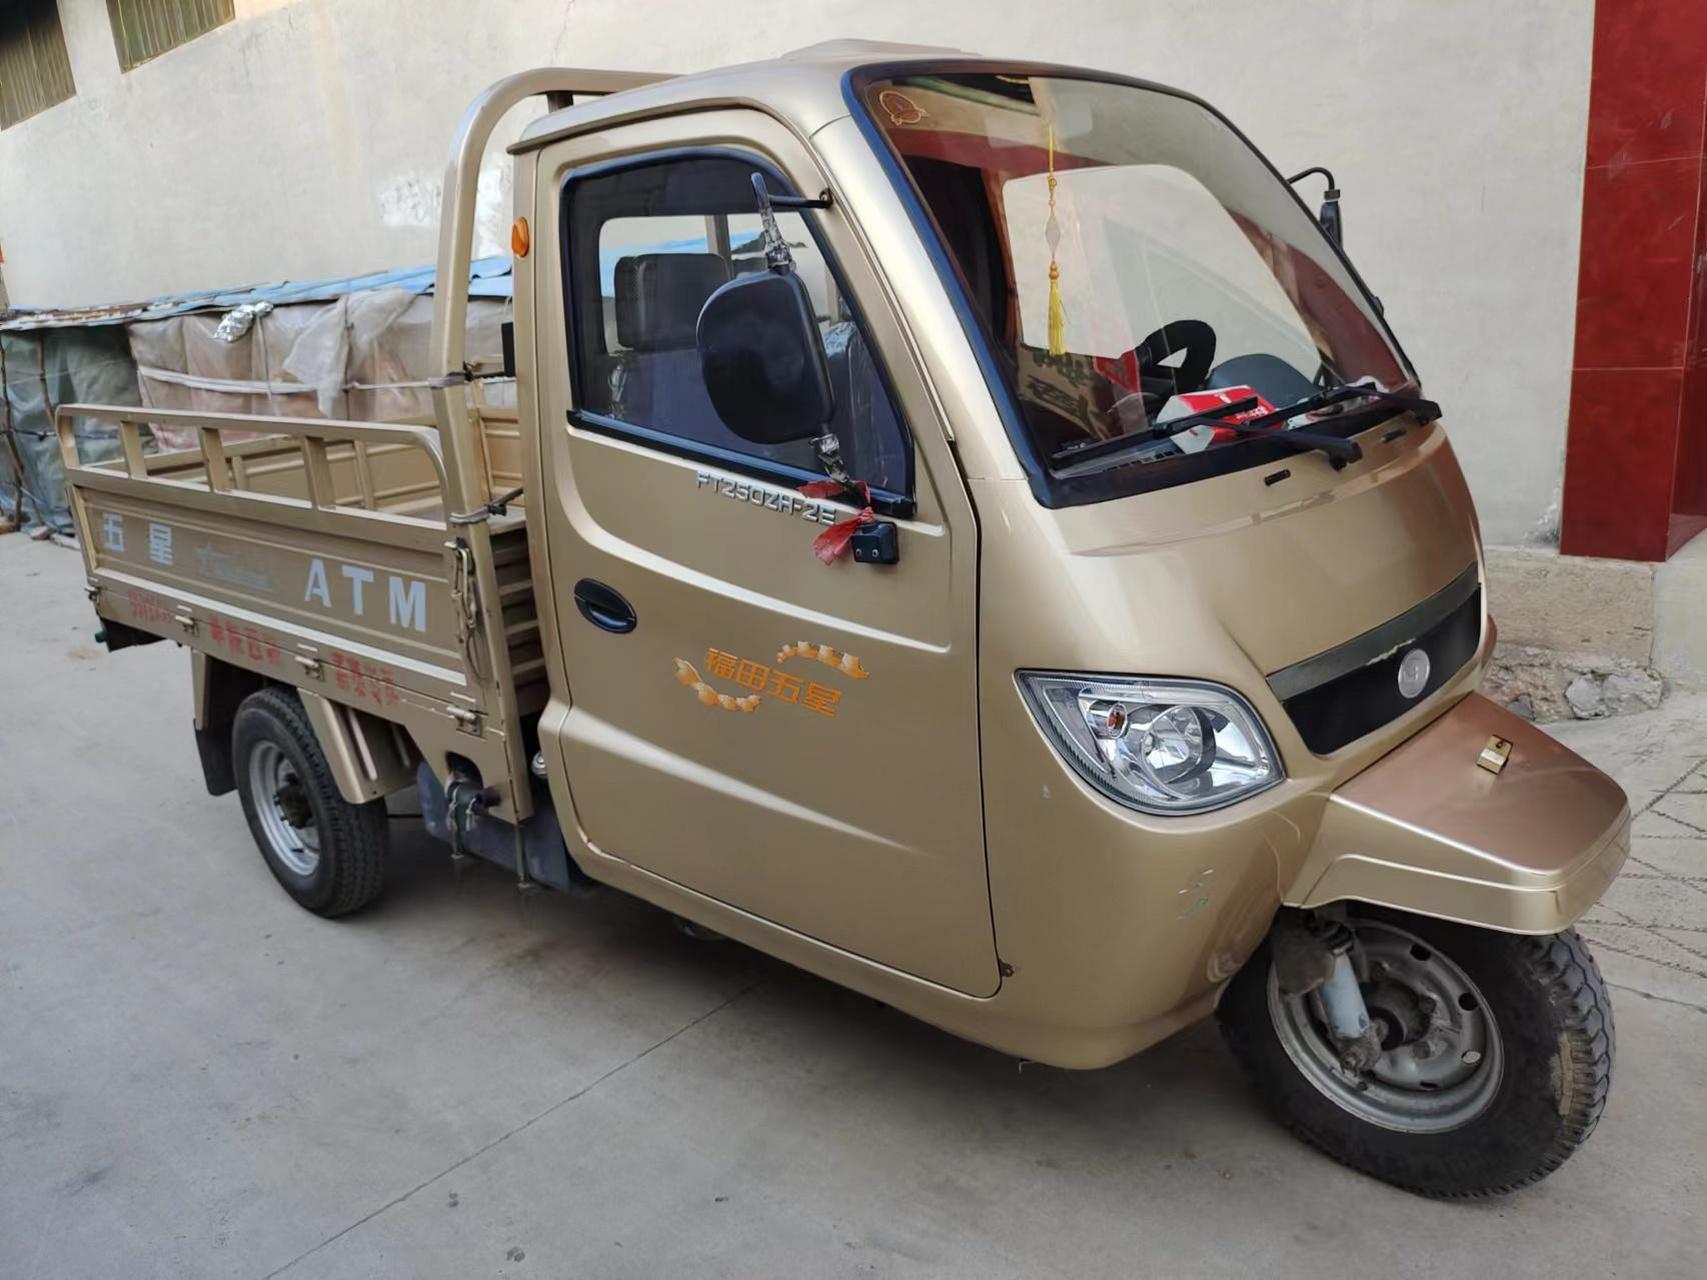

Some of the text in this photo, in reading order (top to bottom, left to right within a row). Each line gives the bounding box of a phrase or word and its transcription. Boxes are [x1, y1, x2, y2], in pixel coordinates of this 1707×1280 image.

[303, 557, 427, 633] ATM
[705, 647, 842, 718] 福田五星
